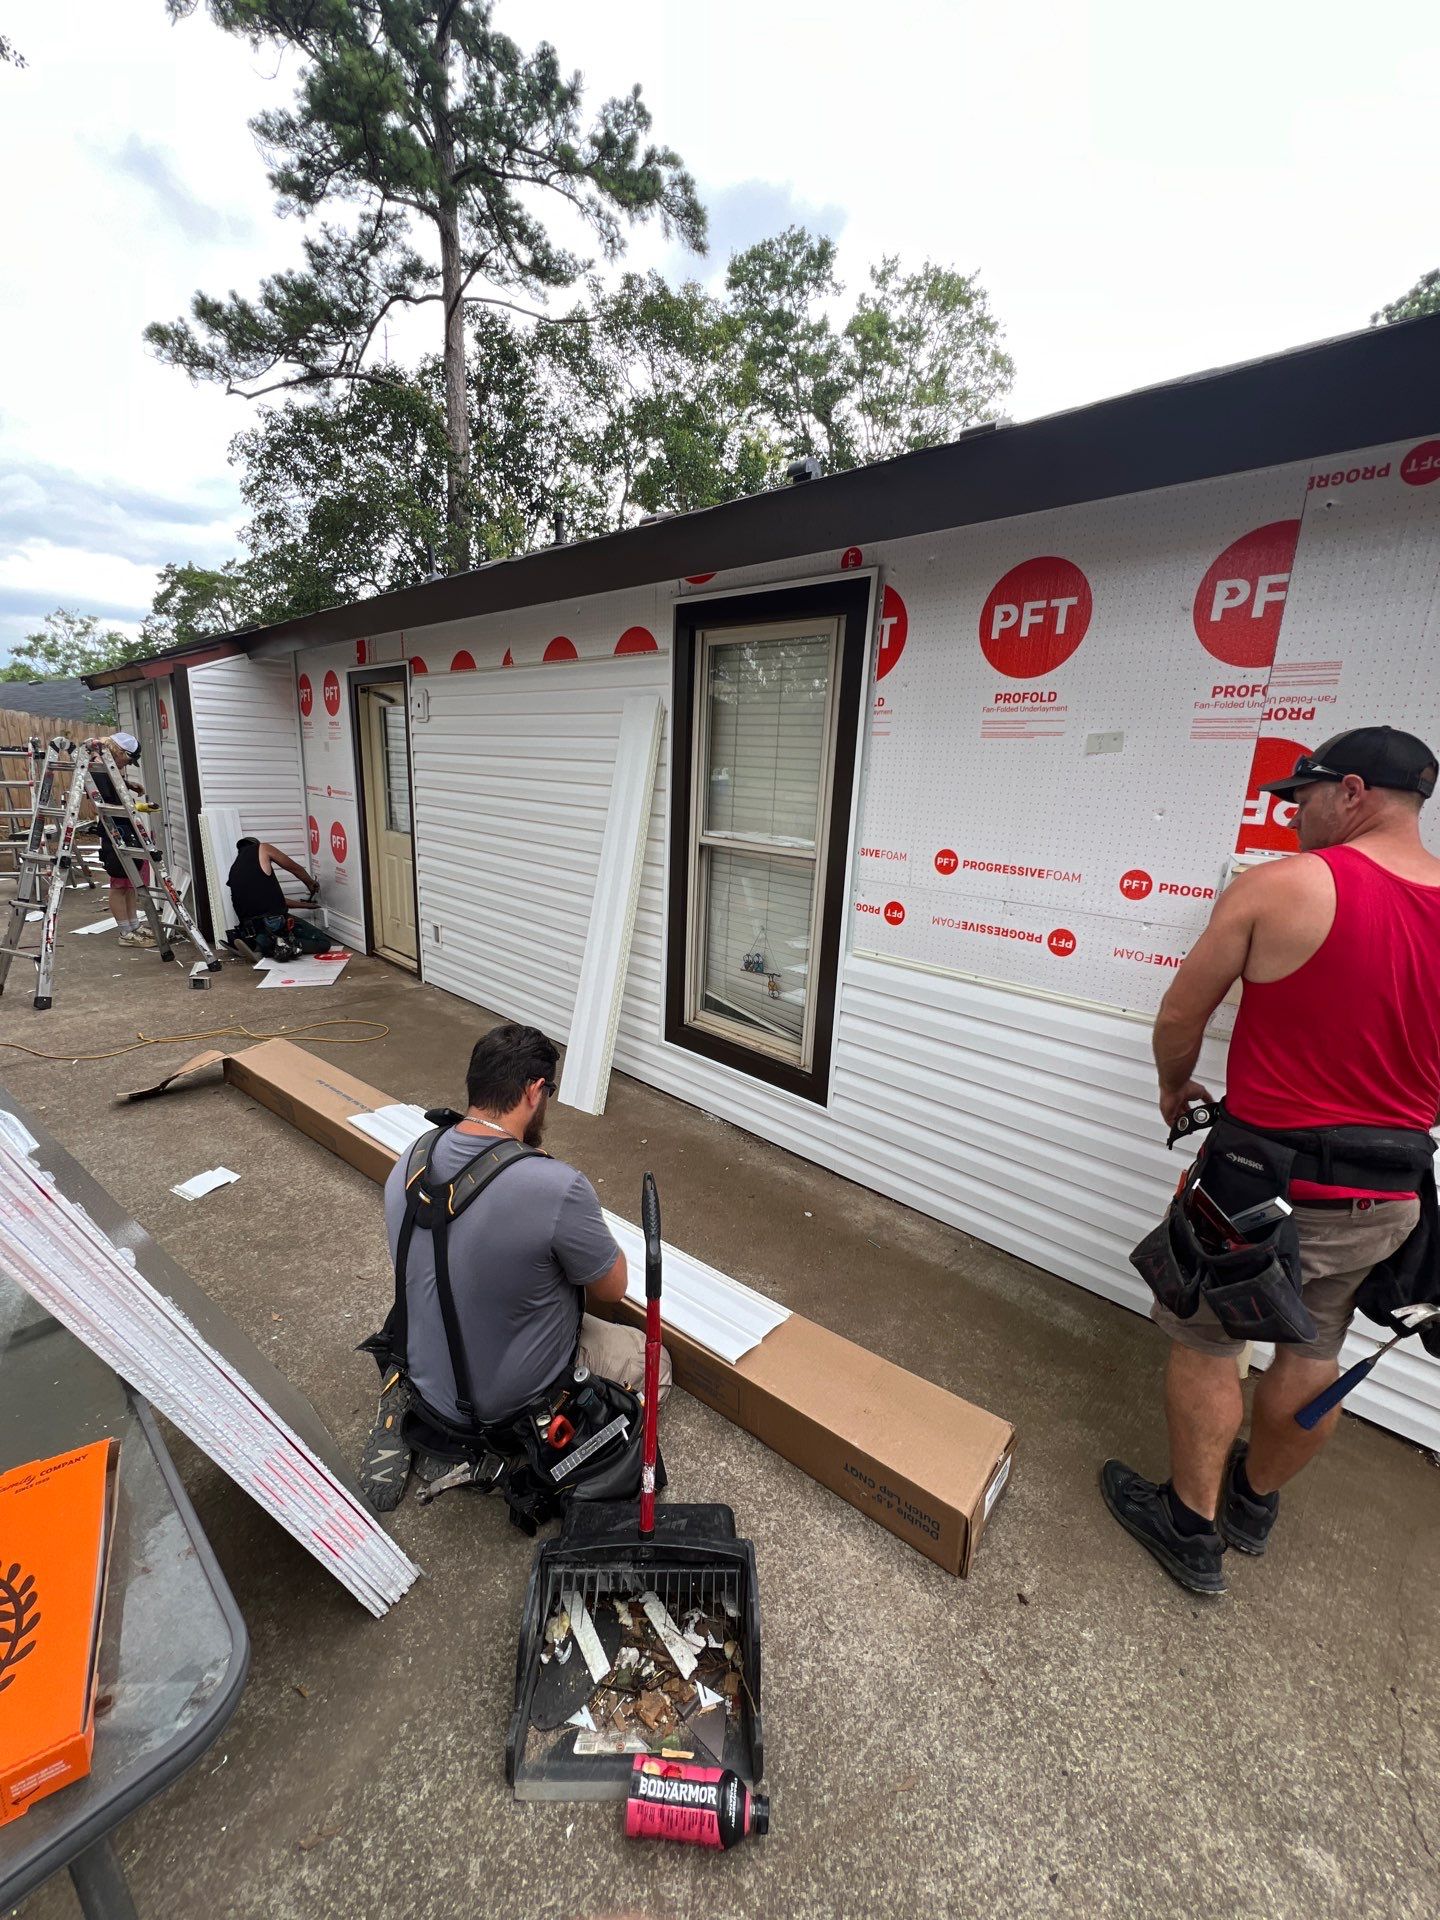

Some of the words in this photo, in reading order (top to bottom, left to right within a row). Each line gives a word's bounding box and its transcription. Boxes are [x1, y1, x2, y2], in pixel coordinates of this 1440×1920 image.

[1210, 573, 1290, 622] PF
[991, 597, 1079, 640] PFT
[325, 686, 338, 701] PFT
[994, 691, 1057, 704] PROFOLD
[1279, 694, 1338, 705] Fan-Folded
[982, 705, 1019, 713] Fan-Folded
[1019, 704, 1069, 714] Underlayment
[1193, 701, 1246, 709] Fan-Folded
[332, 834, 345, 851] PFT
[857, 847, 907, 861] SIVEFOAM
[936, 857, 956, 867] PFT
[962, 859, 1082, 883] PROGRESSIVEFOAM
[1122, 879, 1149, 891] PFT
[1158, 882, 1216, 900] PROGR
[854, 902, 881, 915] PROG
[886, 908, 903, 919] PFT
[931, 915, 1044, 944] PROGRESSIVEFOAM
[1050, 936, 1074, 949] PFT
[40, 1453, 88, 1477] COMPANY
[879, 1486, 901, 1506] Lap
[896, 1507, 940, 1541] Double
[904, 1501, 940, 1532] Dutch
[639, 1775, 717, 1805] BODYARMOR
